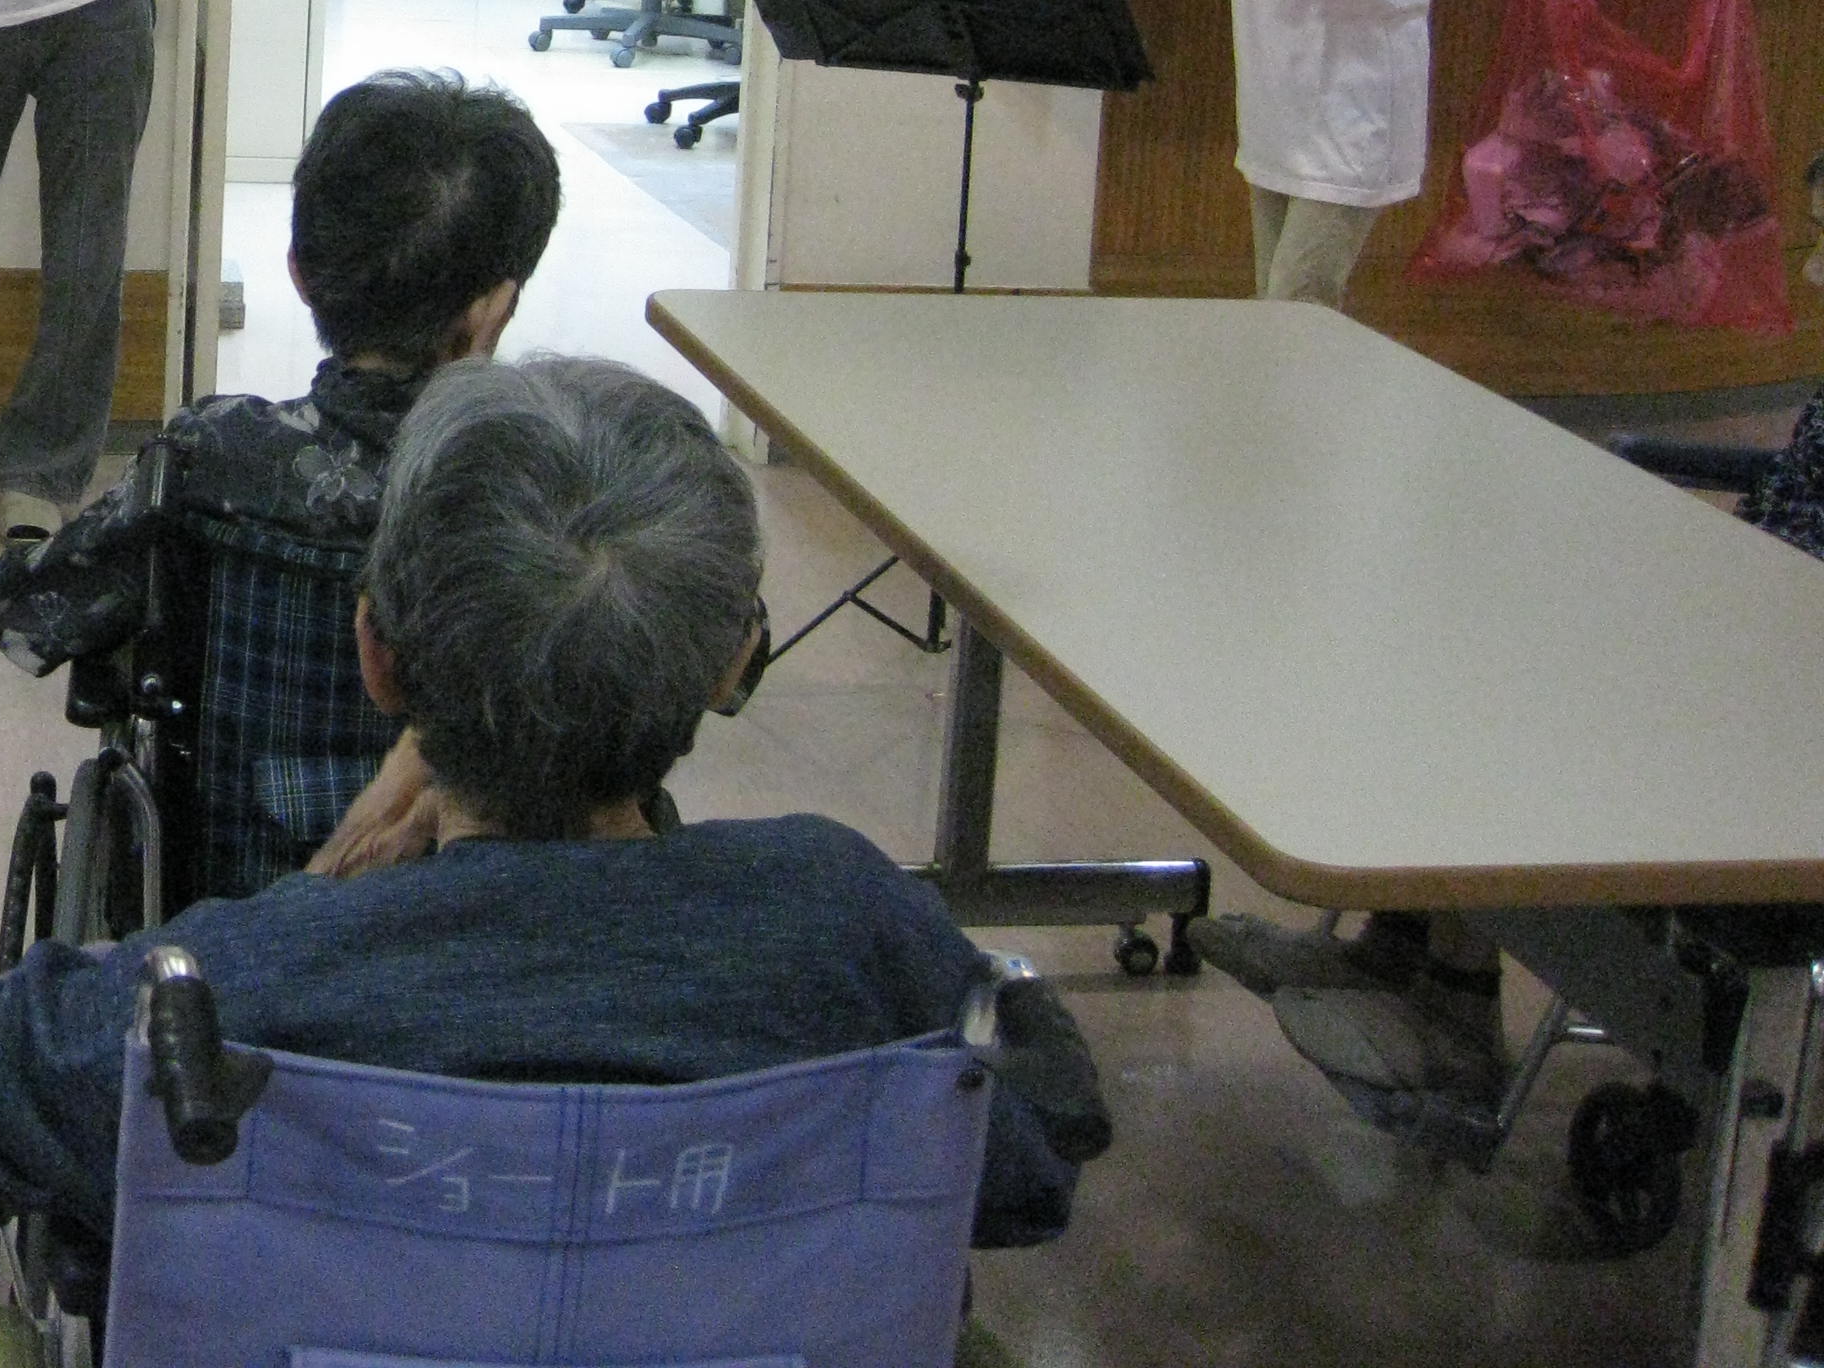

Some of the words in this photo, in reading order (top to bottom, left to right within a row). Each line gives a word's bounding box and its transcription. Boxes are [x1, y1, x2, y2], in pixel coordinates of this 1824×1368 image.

[377, 1118, 733, 1215] ショート用
